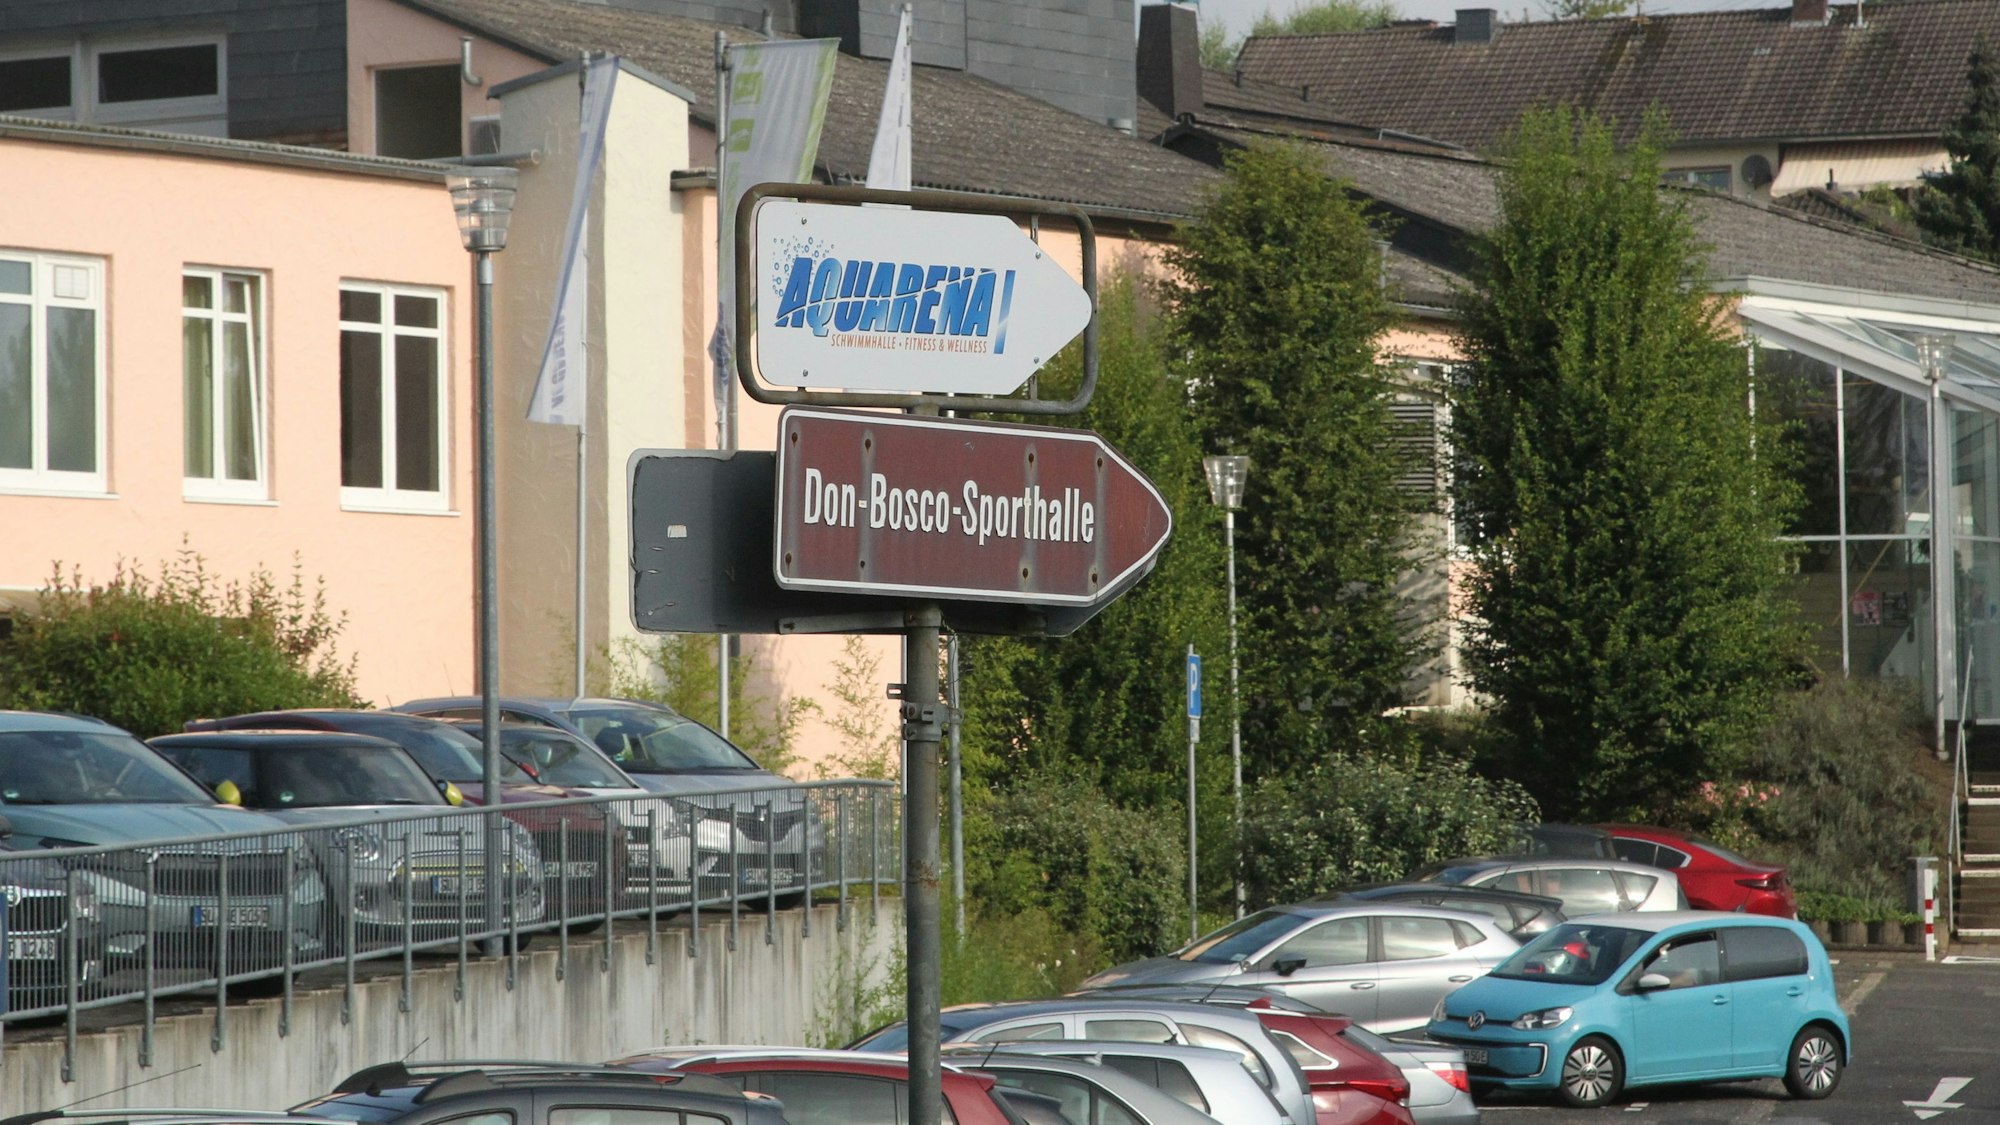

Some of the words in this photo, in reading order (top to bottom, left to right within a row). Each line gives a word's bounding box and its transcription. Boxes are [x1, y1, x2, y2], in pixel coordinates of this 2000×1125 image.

[831, 333, 896, 349] SCHWIMMHALLE
[904, 337, 936, 351] FITNESS
[938, 339, 945, 352] &
[947, 339, 988, 353] WELLNESS
[804, 467, 1095, 546] Don-Bosco-Sporthalle
[1190, 662, 1198, 708] P
